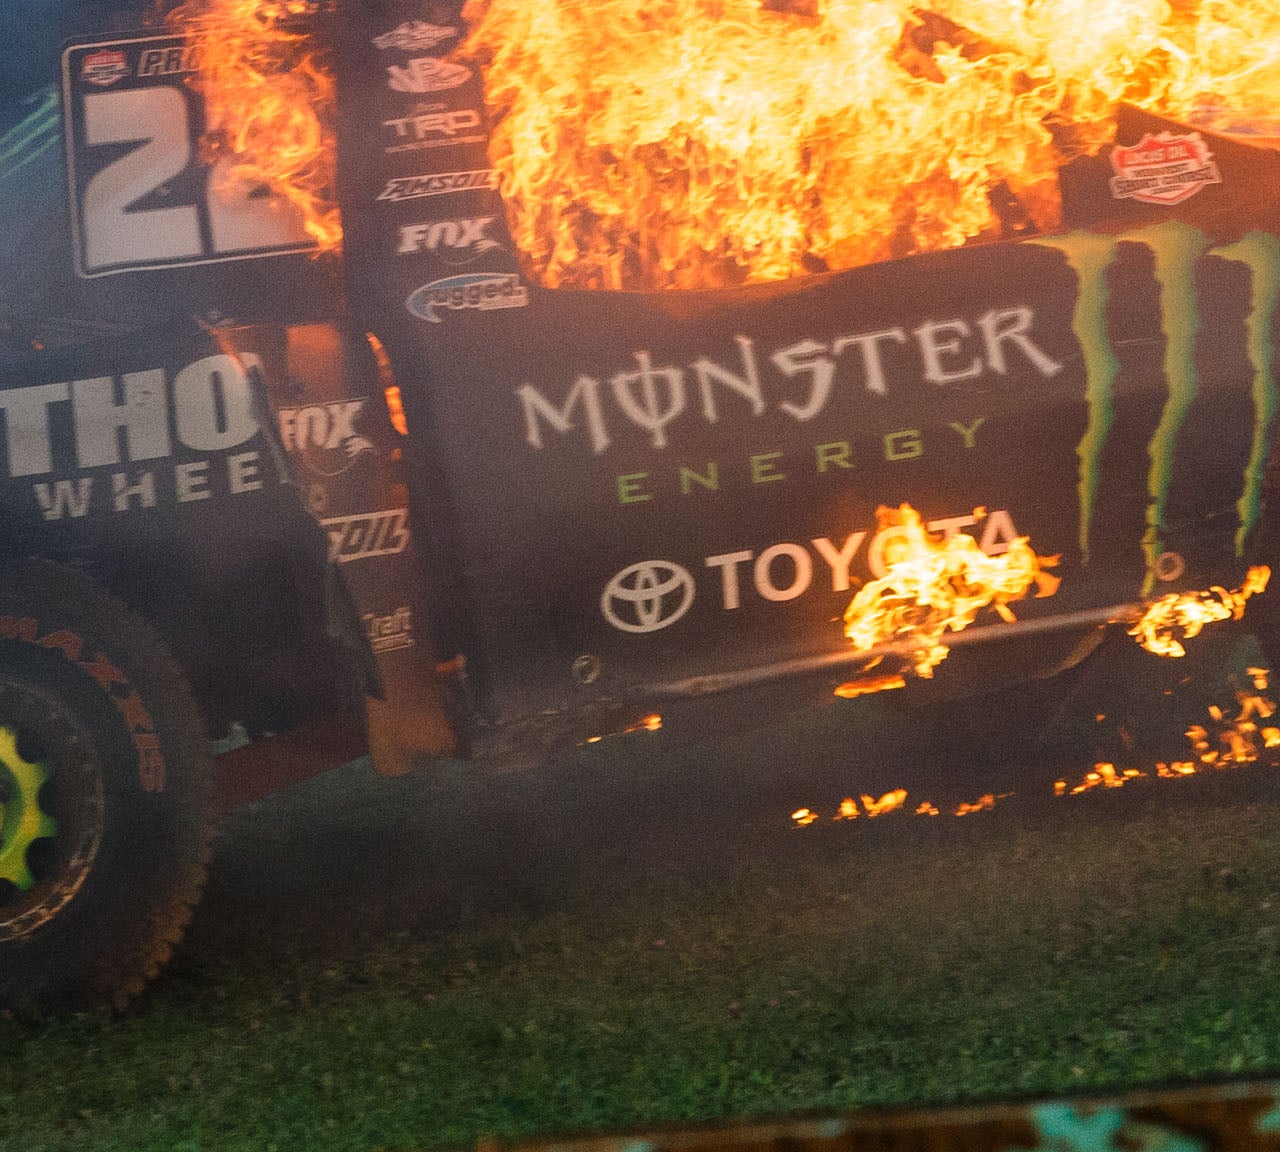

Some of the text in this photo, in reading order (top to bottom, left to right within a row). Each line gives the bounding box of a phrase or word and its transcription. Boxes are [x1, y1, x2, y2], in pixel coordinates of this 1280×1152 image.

[383, 109, 481, 139] TRD
[396, 215, 499, 255] FOX
[517, 307, 1064, 455] MONSTER
[278, 400, 374, 457] FOX
[34, 450, 280, 521] WHEE
[618, 418, 987, 505] ENERGY
